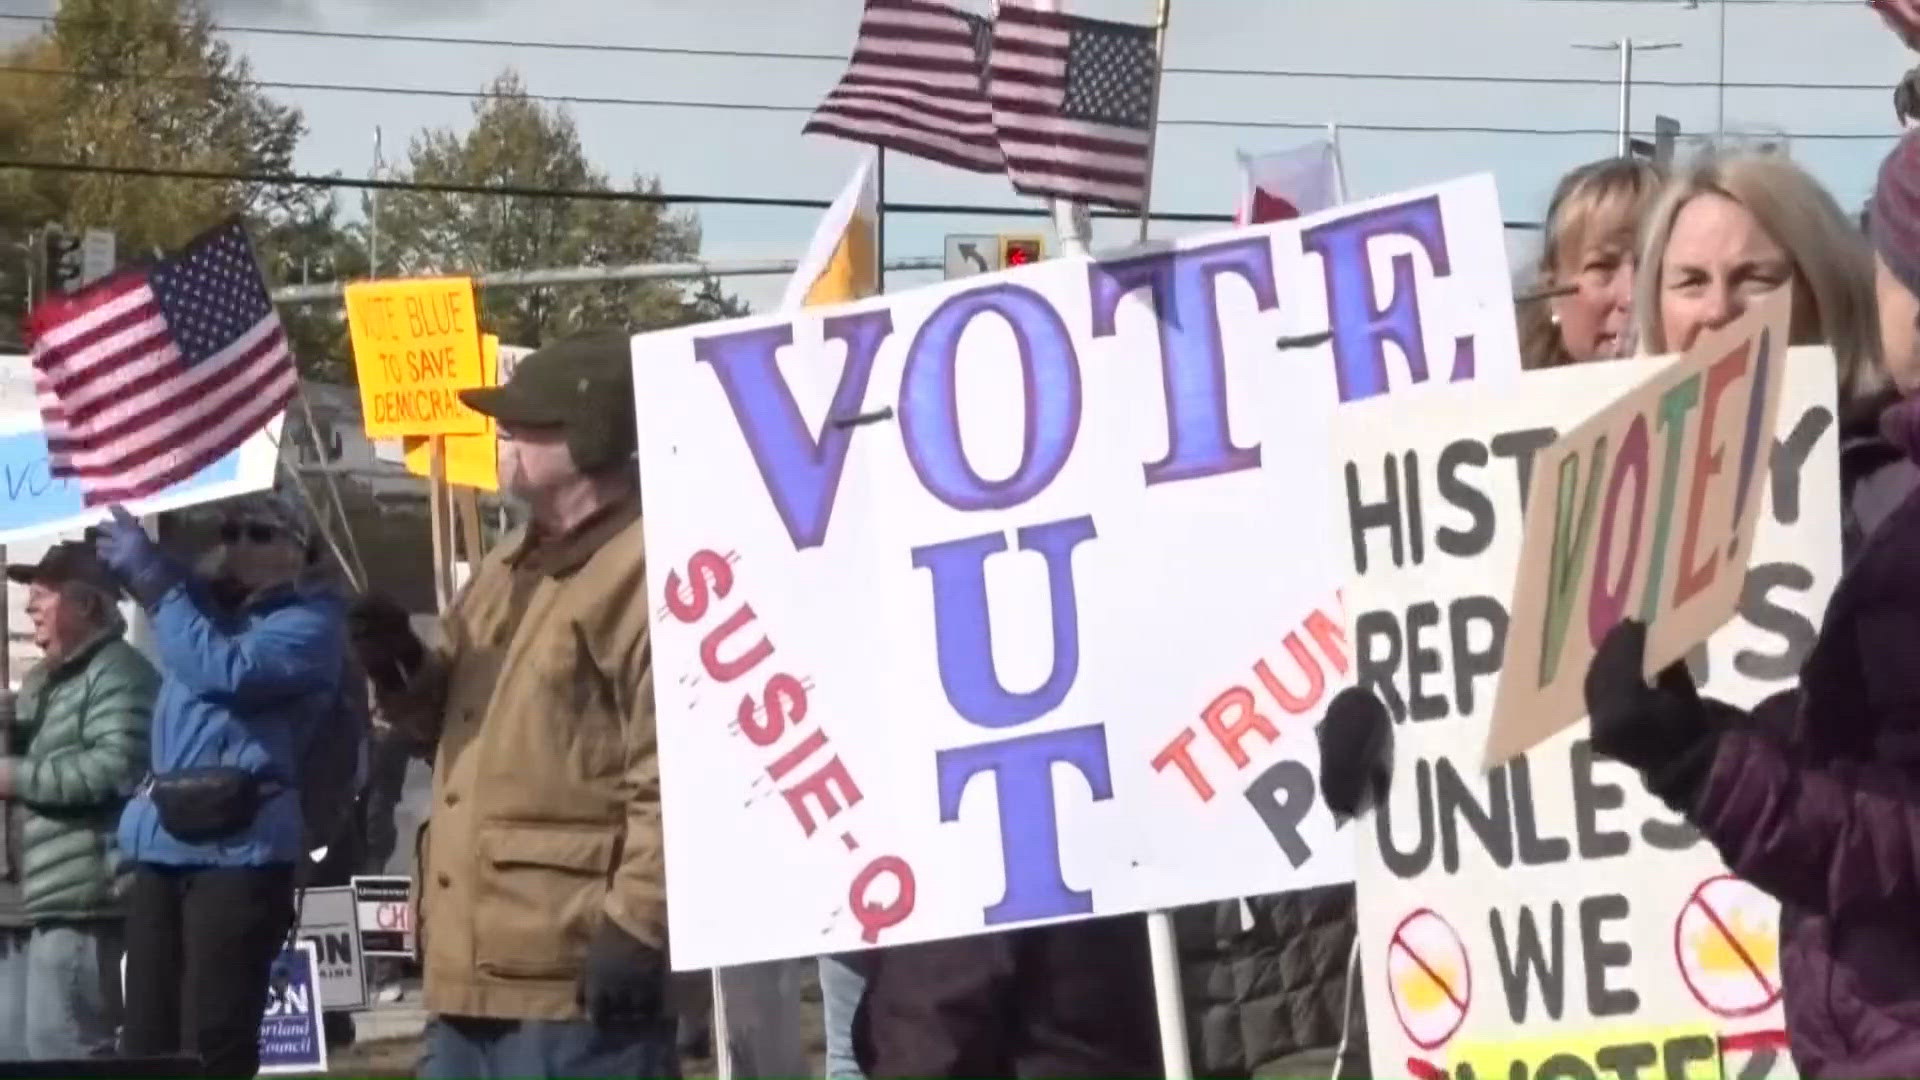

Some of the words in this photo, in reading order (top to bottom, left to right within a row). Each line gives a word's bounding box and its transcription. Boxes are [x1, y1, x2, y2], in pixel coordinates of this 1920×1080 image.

[378, 352, 402, 384] TO
[406, 347, 457, 383] SAVE
[406, 291, 464, 338] BLUE
[694, 194, 1475, 552] VOTE
[374, 388, 462, 425] DEMOCRA
[1344, 404, 1834, 576] HISTY
[1539, 327, 1770, 690] VOTE!
[1355, 561, 1819, 725] REPS
[1375, 738, 1701, 878] UNLE
[1489, 893, 1640, 1025] WE
